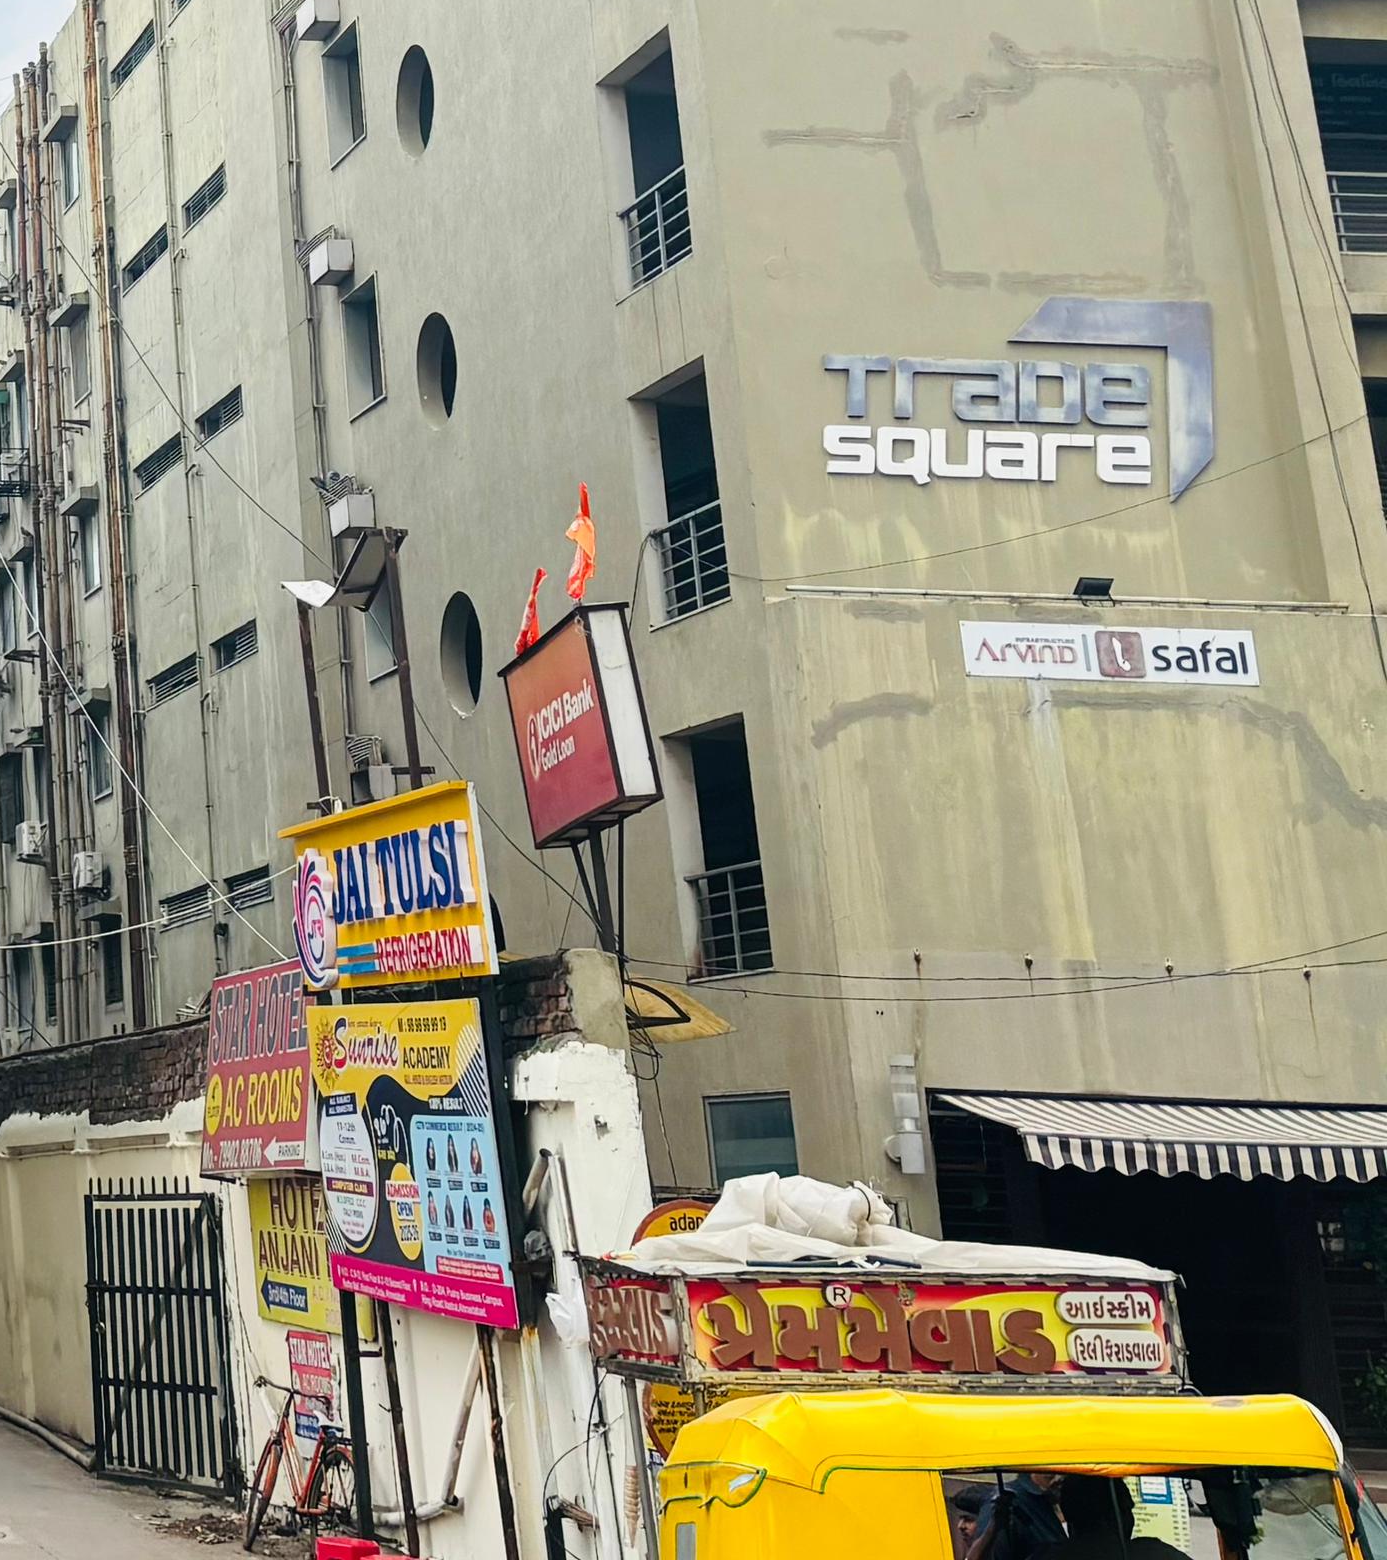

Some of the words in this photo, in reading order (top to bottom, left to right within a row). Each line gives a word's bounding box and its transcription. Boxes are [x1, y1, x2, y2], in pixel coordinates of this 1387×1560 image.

[1152, 640, 1249, 676] safal
[564, 677, 595, 727] Bank
[332, 841, 375, 925] JAI
[375, 819, 470, 917] TULSI
[376, 926, 476, 976] REFRIGERATION
[212, 980, 253, 1067] STAR
[333, 1017, 400, 1069] Sunrise
[403, 1045, 451, 1070] ACADEMY
[222, 1074, 245, 1129] AC
[246, 1065, 303, 1127] ROOMS
[396, 1201, 414, 1217] OPEN
[258, 1230, 320, 1282] ANJANI
